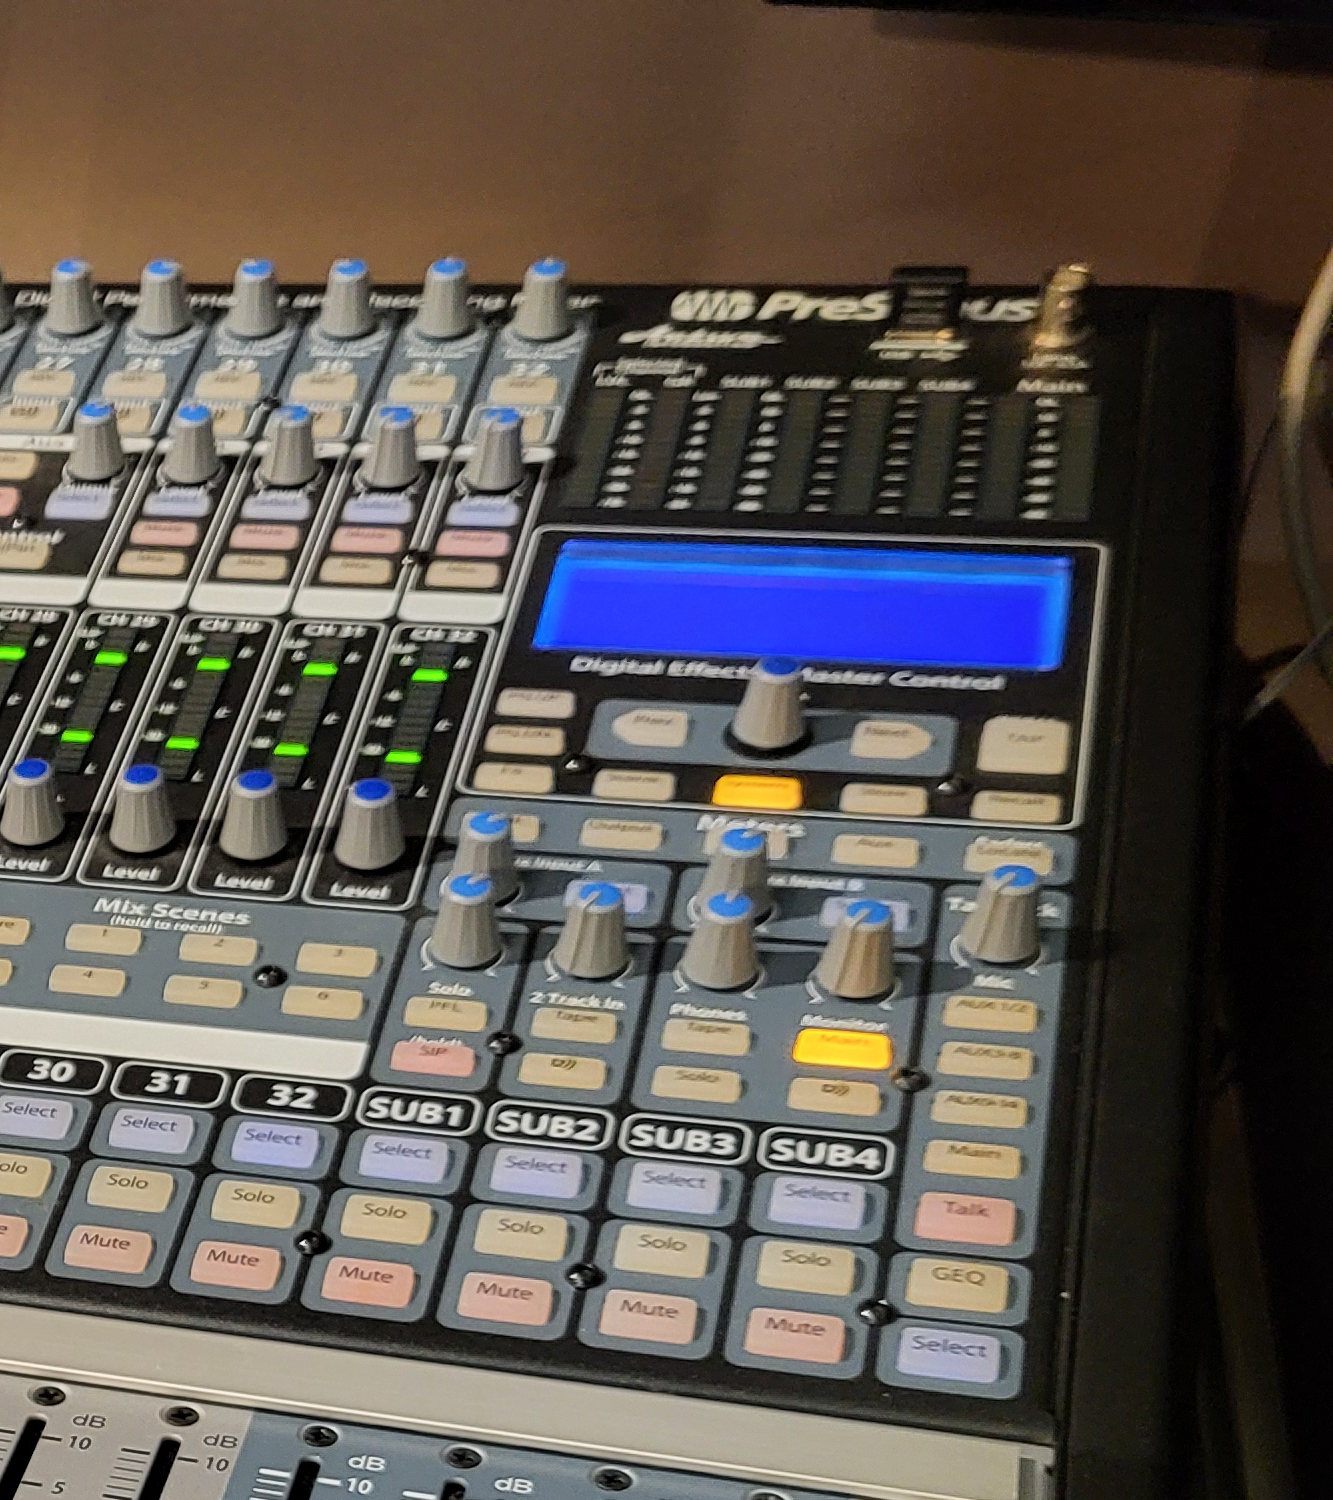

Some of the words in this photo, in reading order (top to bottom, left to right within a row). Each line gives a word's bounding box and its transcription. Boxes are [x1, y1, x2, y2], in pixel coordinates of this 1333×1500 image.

[889, 671, 1007, 690] Control
[104, 864, 160, 882] Level
[215, 873, 273, 891] Level
[93, 898, 148, 915] Mix
[151, 902, 252, 925] Scenes
[428, 982, 472, 997] Solo
[669, 1003, 748, 1021] Phones
[26, 1059, 75, 1083] 30
[144, 1073, 192, 1096] 31
[266, 1085, 315, 1108] 32
[367, 1096, 464, 1128] SUB1
[120, 1114, 179, 1133] Select
[494, 1108, 600, 1142] SUB2
[243, 1127, 303, 1146] Select
[630, 1122, 738, 1157] SUB3
[371, 1141, 433, 1160] Select
[770, 1138, 882, 1171] SUB4
[949, 1145, 1003, 1160] Main
[504, 1154, 569, 1174] Select
[106, 1173, 150, 1190] Solo
[641, 1169, 708, 1190] Select
[231, 1187, 276, 1205] Solo
[783, 1182, 852, 1203] Select
[362, 1202, 408, 1220] Solo
[942, 1199, 990, 1218] Talk
[79, 1232, 131, 1251] Mute
[637, 1233, 688, 1252] Solo
[206, 1248, 260, 1267] Mute
[780, 1249, 832, 1268] Solo
[338, 1264, 395, 1284] Mute
[931, 1266, 987, 1287] GEQ
[619, 1299, 680, 1320] Mute
[764, 1316, 827, 1337] Mute
[911, 1334, 988, 1358] Select
